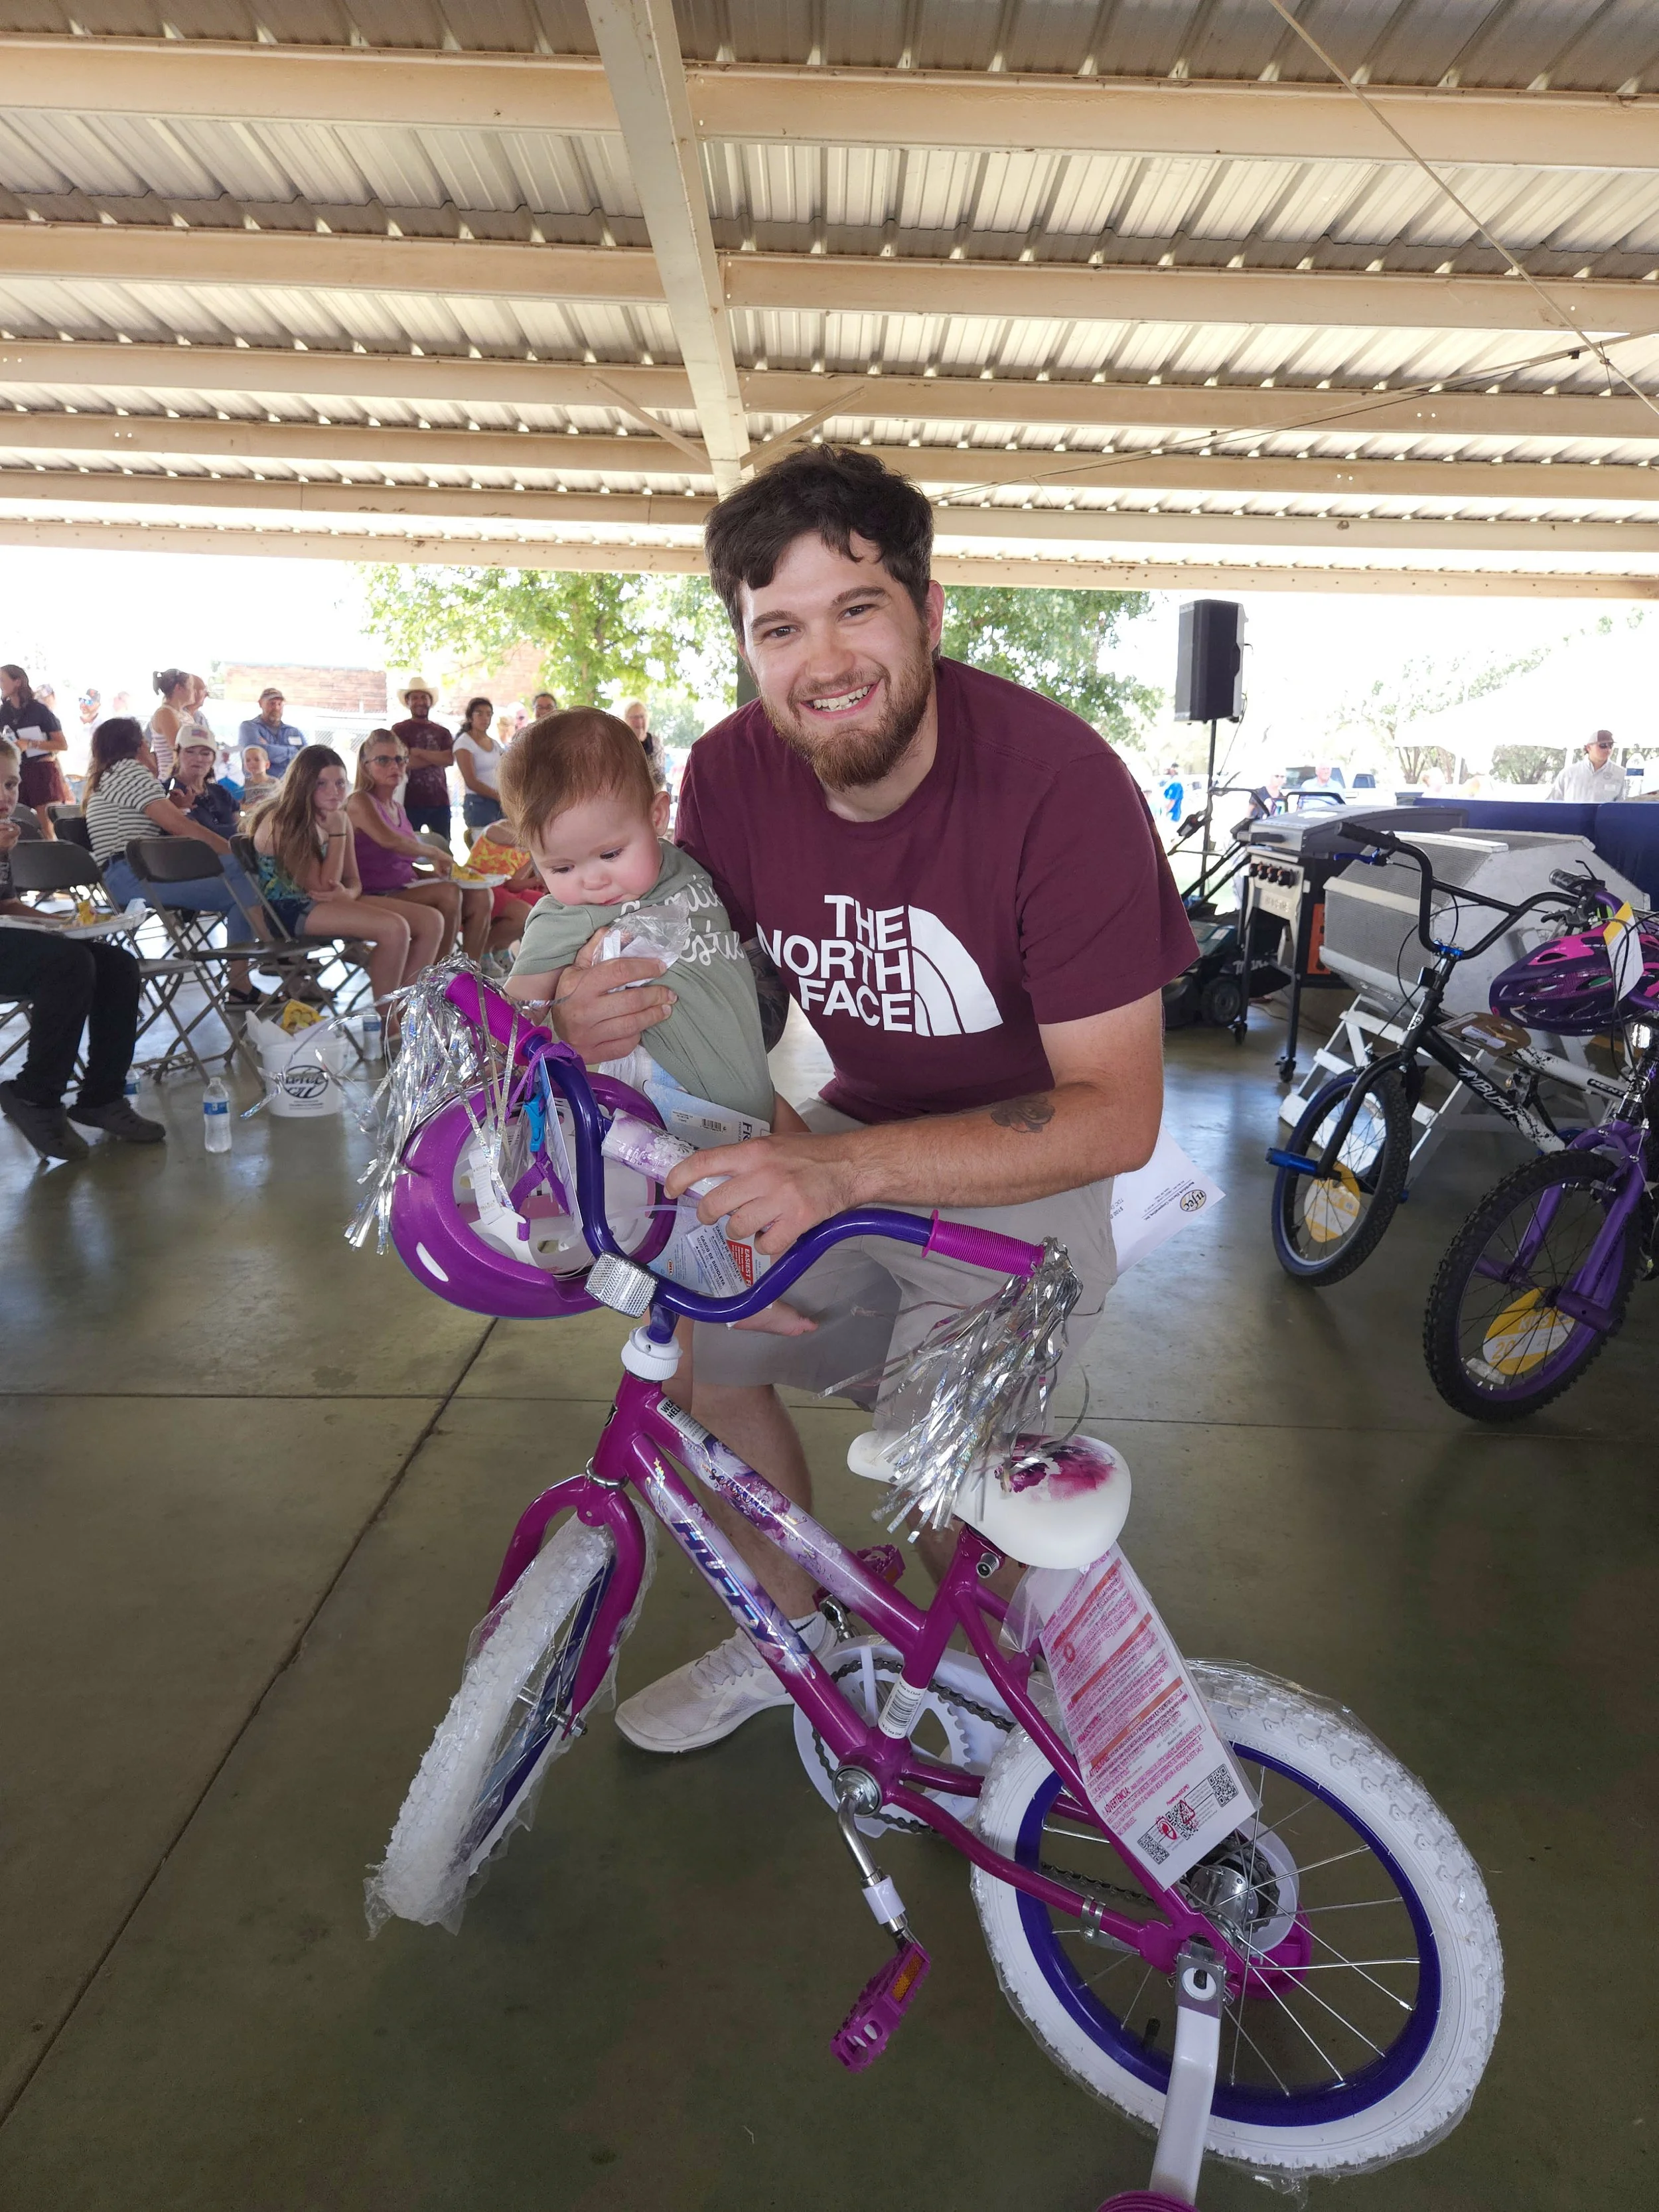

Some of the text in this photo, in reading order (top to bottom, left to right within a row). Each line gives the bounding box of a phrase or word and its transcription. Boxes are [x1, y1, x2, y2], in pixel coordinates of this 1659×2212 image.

[824, 895, 907, 950] THE
[756, 922, 911, 990] NORTH
[798, 977, 912, 1033] FACE
[1458, 1063, 1520, 1117] AMBUSH
[1112, 1206, 1123, 1217] $100
[1184, 1192, 1204, 1210] nfec
[700, 1235, 710, 1253] CASCO
[711, 1260, 725, 1286] BICICLETA
[715, 1226, 725, 1245] CASQUE
[728, 1253, 743, 1282] BICYCLETTE
[660, 1399, 676, 1413] WEA
[667, 1405, 681, 1420] HEL
[671, 1518, 784, 1649] HUFFY
[1104, 1785, 1131, 1813] ADVERTÊNCIA:
